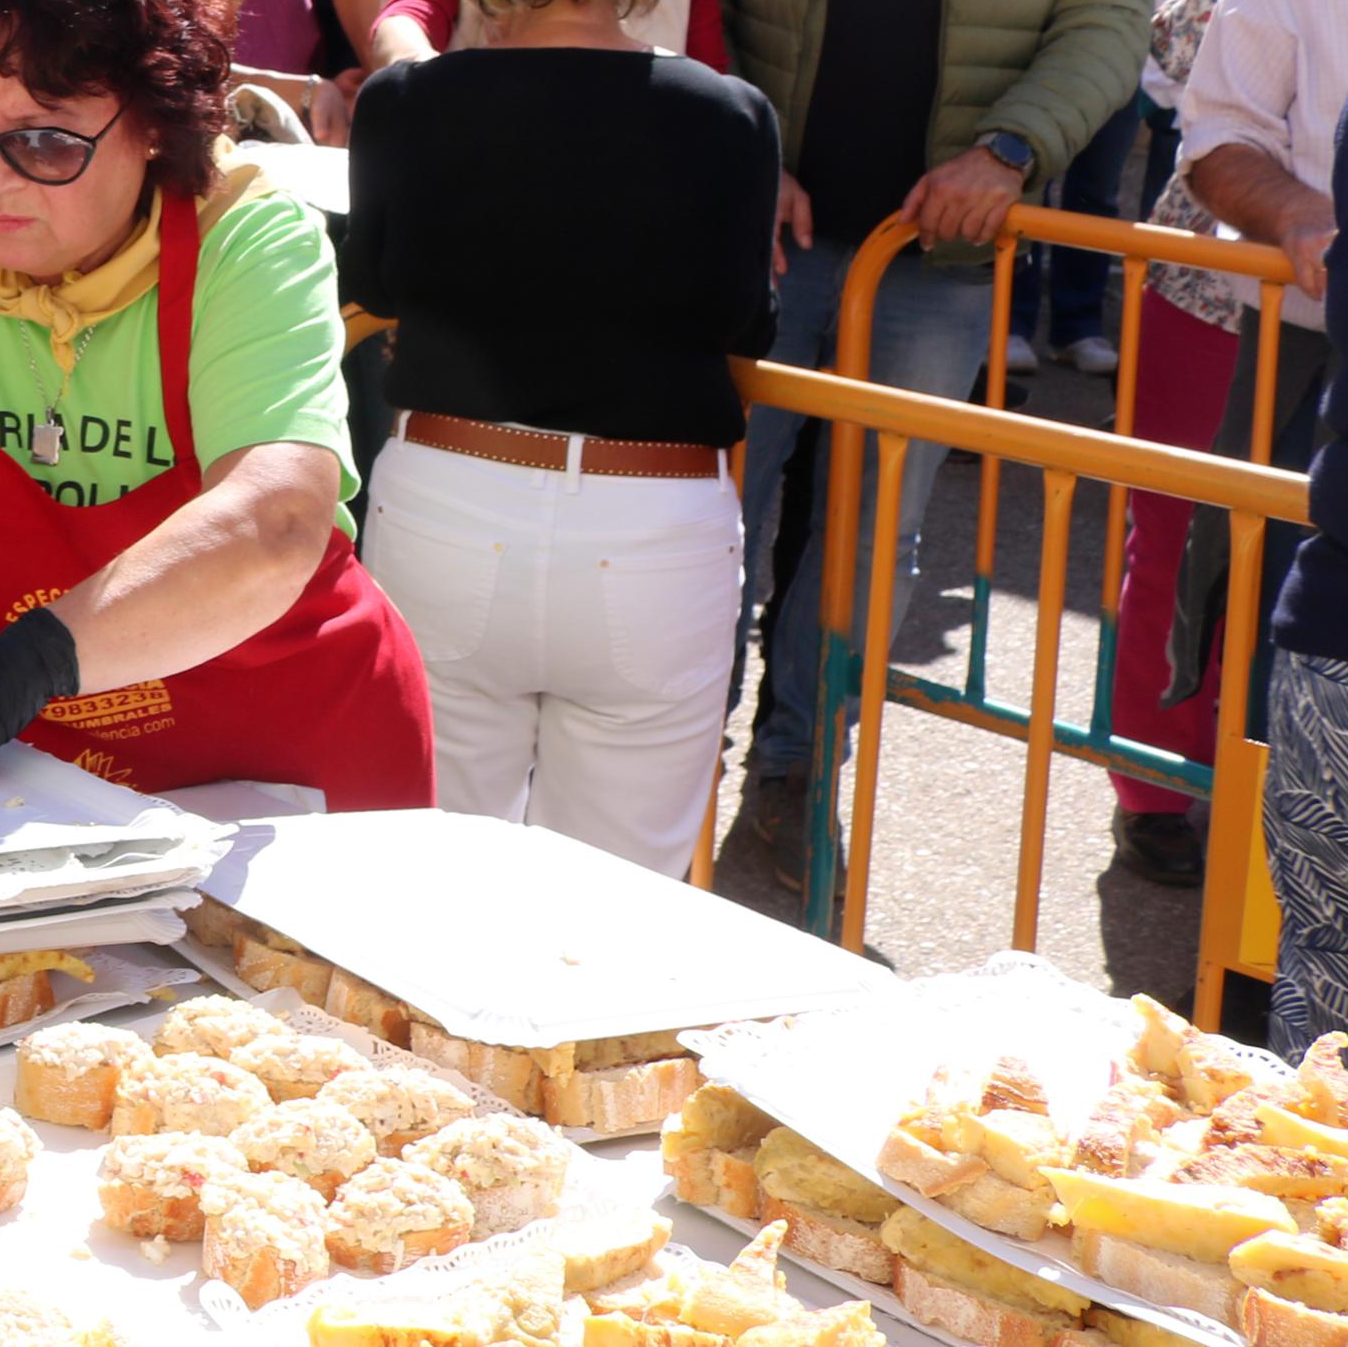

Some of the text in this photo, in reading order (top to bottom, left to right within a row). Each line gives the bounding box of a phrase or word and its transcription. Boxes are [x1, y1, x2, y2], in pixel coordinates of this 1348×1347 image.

[79, 415, 133, 459] DE
[146, 426, 177, 467] L
[62, 702, 173, 730] UMBRALES
